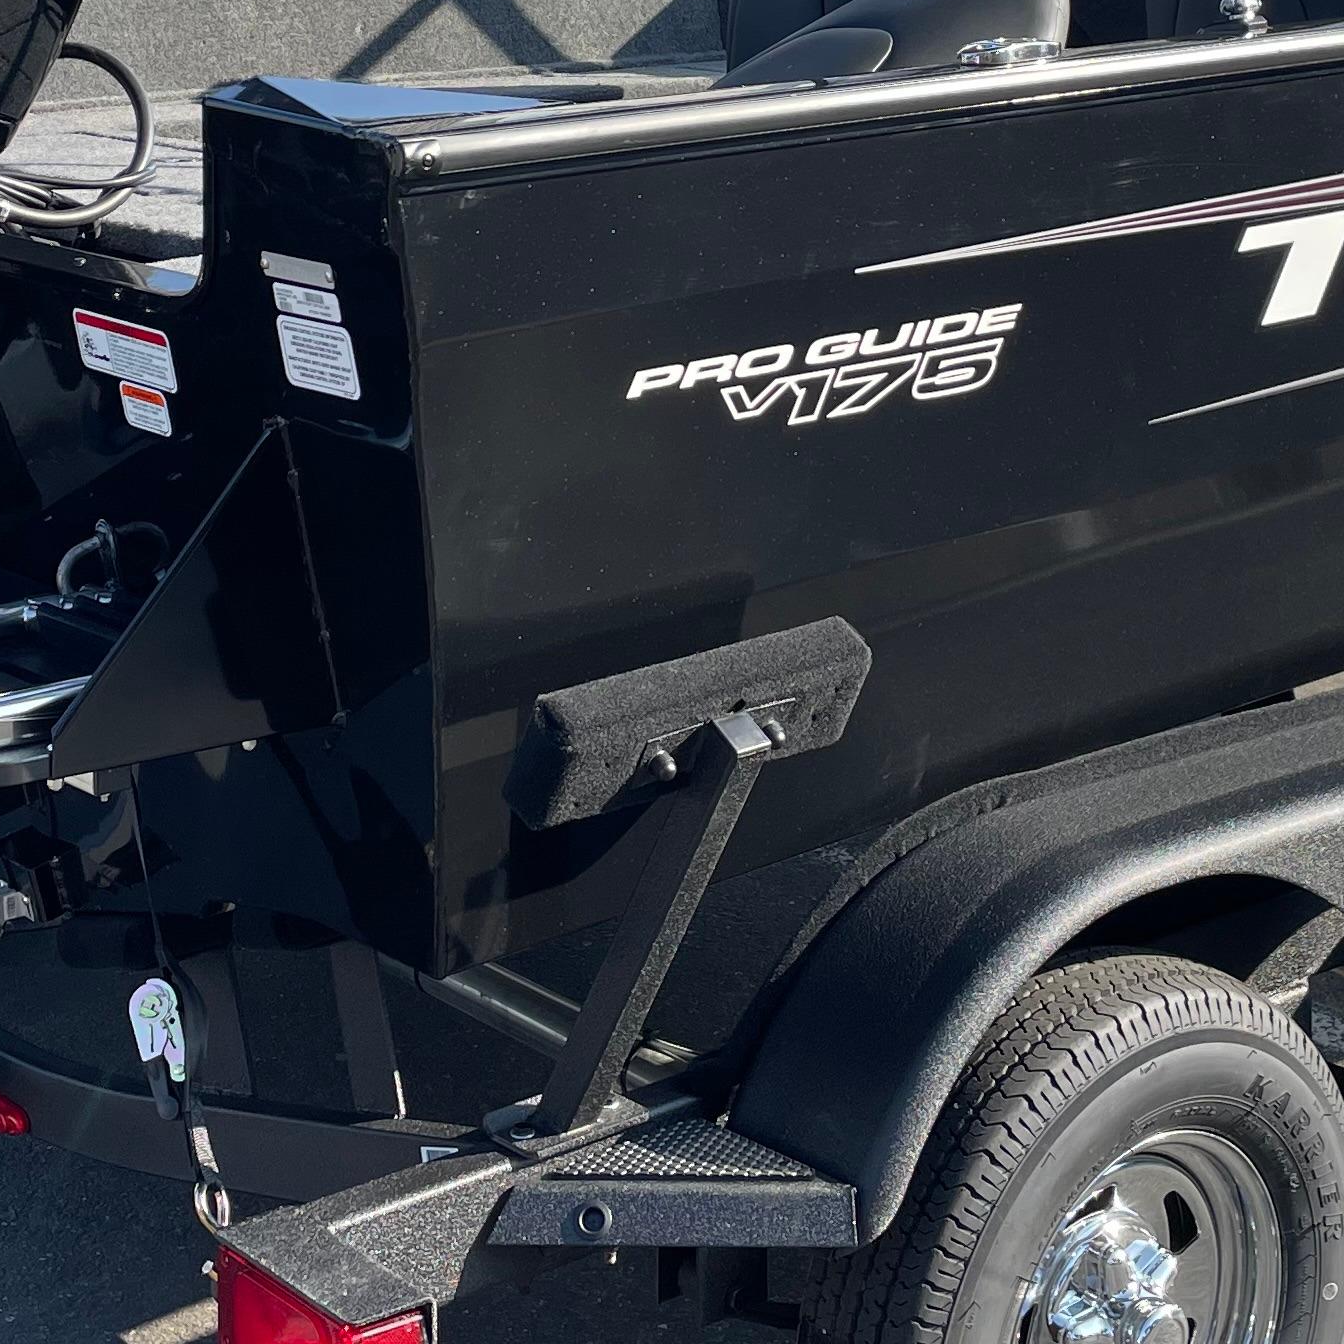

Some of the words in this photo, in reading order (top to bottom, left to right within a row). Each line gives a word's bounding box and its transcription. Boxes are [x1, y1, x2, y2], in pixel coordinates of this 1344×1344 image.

[625, 343, 796, 401] PRO
[804, 302, 1024, 366] GUIDE
[719, 337, 1006, 427] V175
[1242, 1072, 1344, 1244] KARRIER
